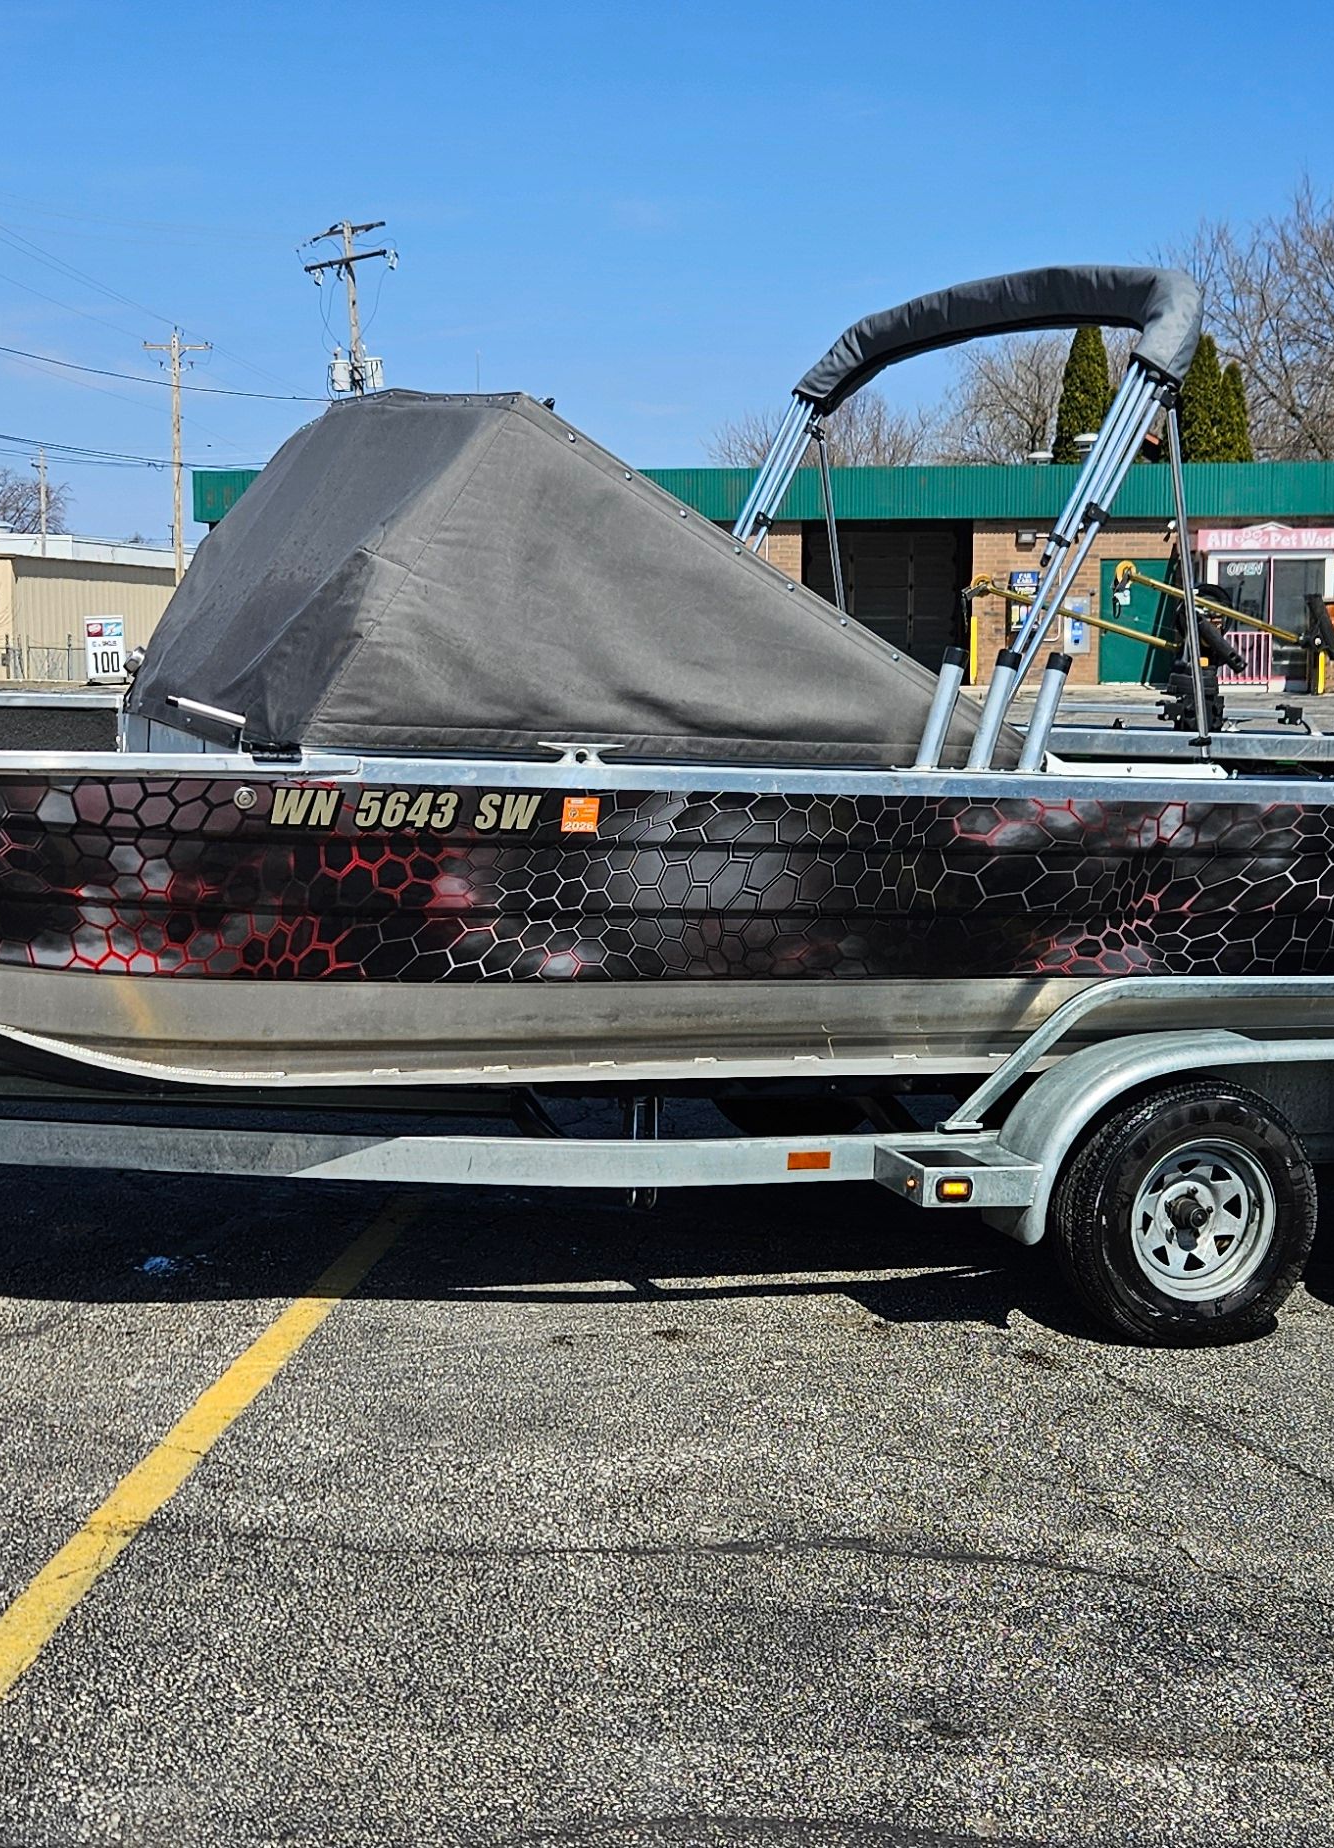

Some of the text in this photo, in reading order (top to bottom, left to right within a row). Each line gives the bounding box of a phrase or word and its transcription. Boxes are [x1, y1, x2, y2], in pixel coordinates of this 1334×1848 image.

[1207, 531, 1233, 548] All
[1270, 531, 1298, 547] Pet
[1226, 561, 1264, 577] OPEN
[92, 651, 121, 674] 100
[269, 788, 542, 830] WN 5643 SW
[564, 821, 594, 831] 2026
